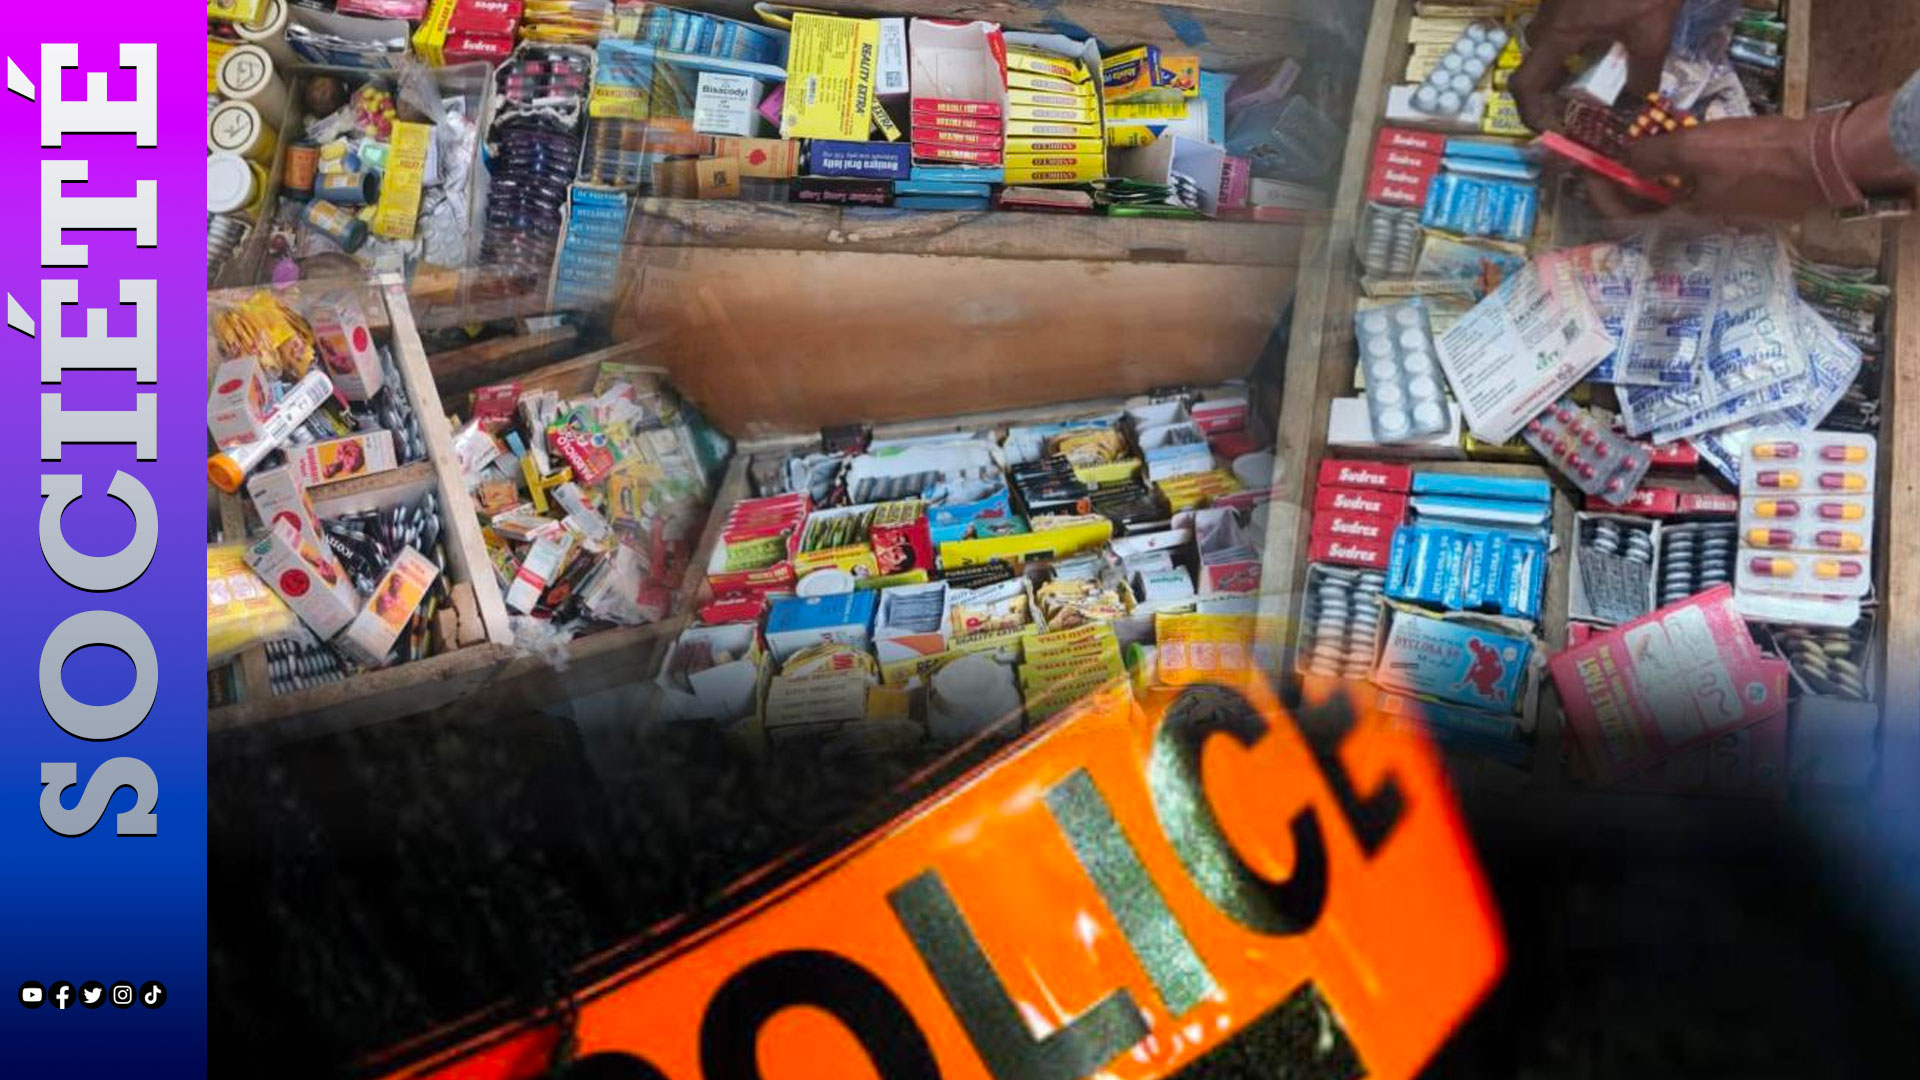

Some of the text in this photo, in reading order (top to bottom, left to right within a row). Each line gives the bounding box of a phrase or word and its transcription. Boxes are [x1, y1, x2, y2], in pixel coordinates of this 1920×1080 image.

[462, 39, 497, 51] Sudrex
[855, 42, 873, 115] REALITY EXTRA
[702, 84, 748, 97] Bisacodyl
[844, 160, 862, 170] Oral
[1338, 467, 1387, 485] Sudrex
[1333, 493, 1382, 512] Sudrex
[1330, 518, 1380, 537] Sudrex
[1327, 543, 1378, 562] Sudrex
